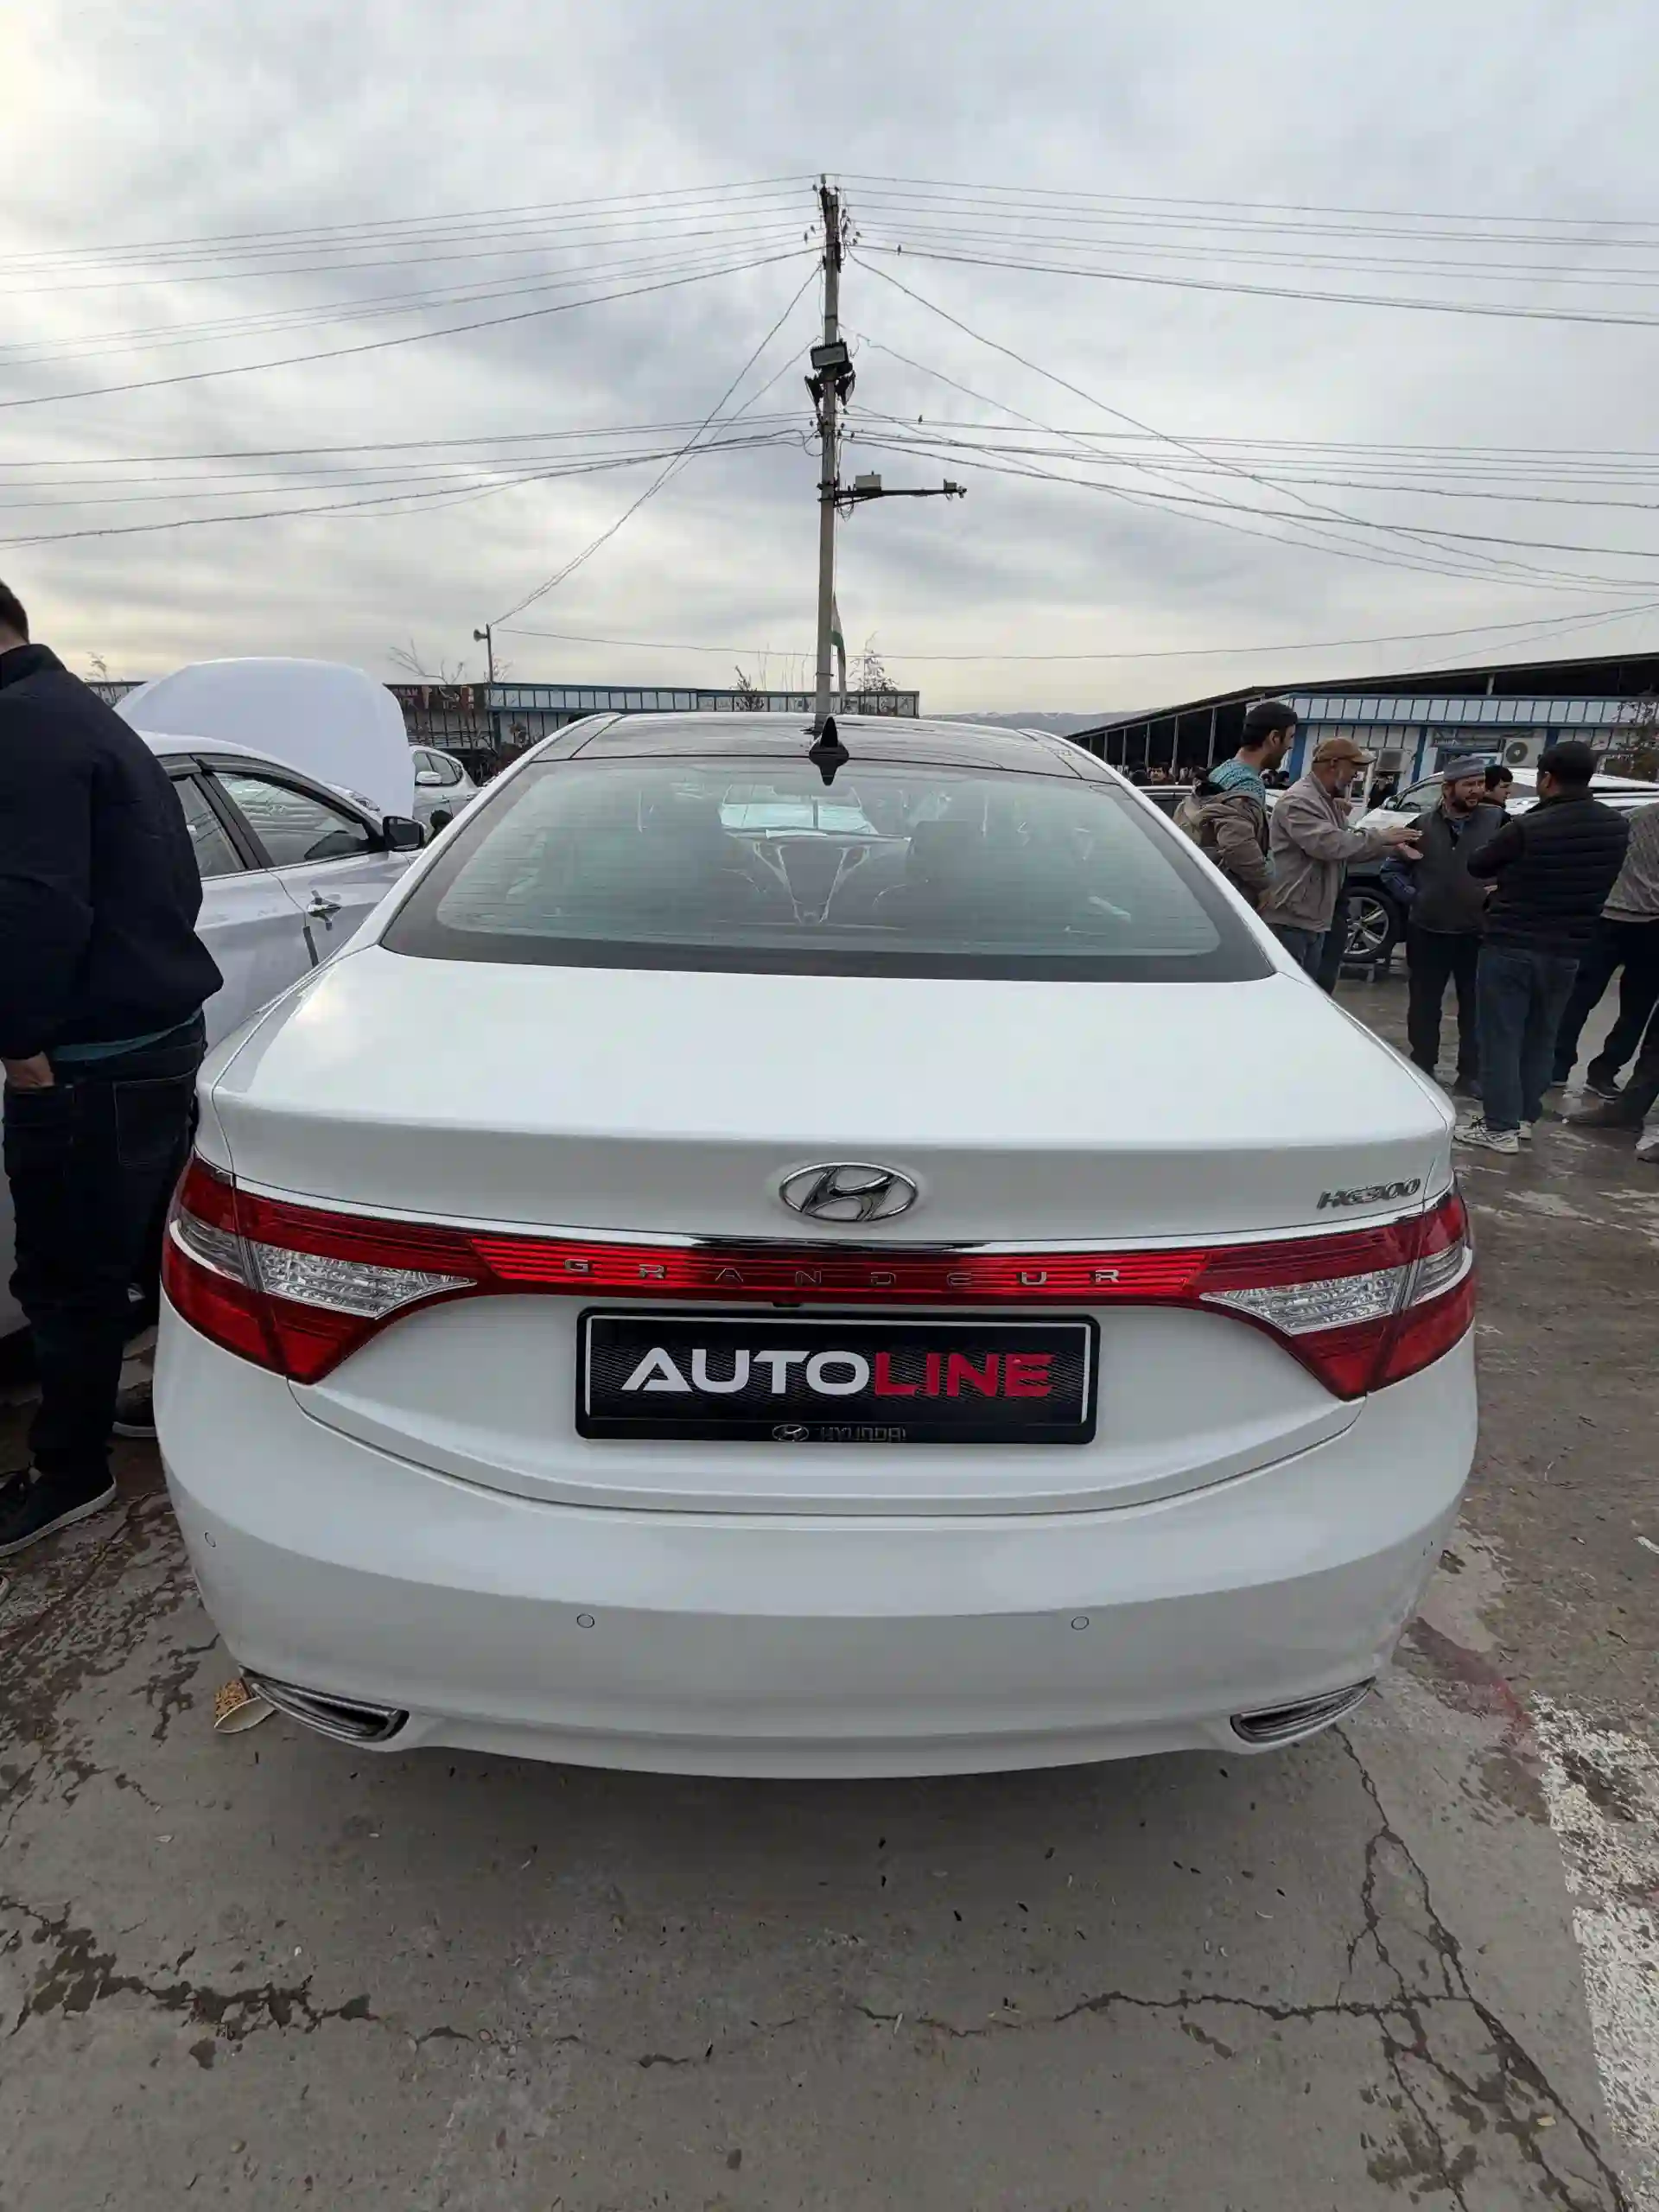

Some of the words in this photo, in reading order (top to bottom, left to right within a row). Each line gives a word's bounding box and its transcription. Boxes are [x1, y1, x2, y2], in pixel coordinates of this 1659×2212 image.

[1316, 1178, 1421, 1210] HG300
[563, 1258, 1121, 1287] GRANDEUR
[620, 1346, 1053, 1396] AUTOLINE
[822, 1427, 906, 1441] HYUNDAI
